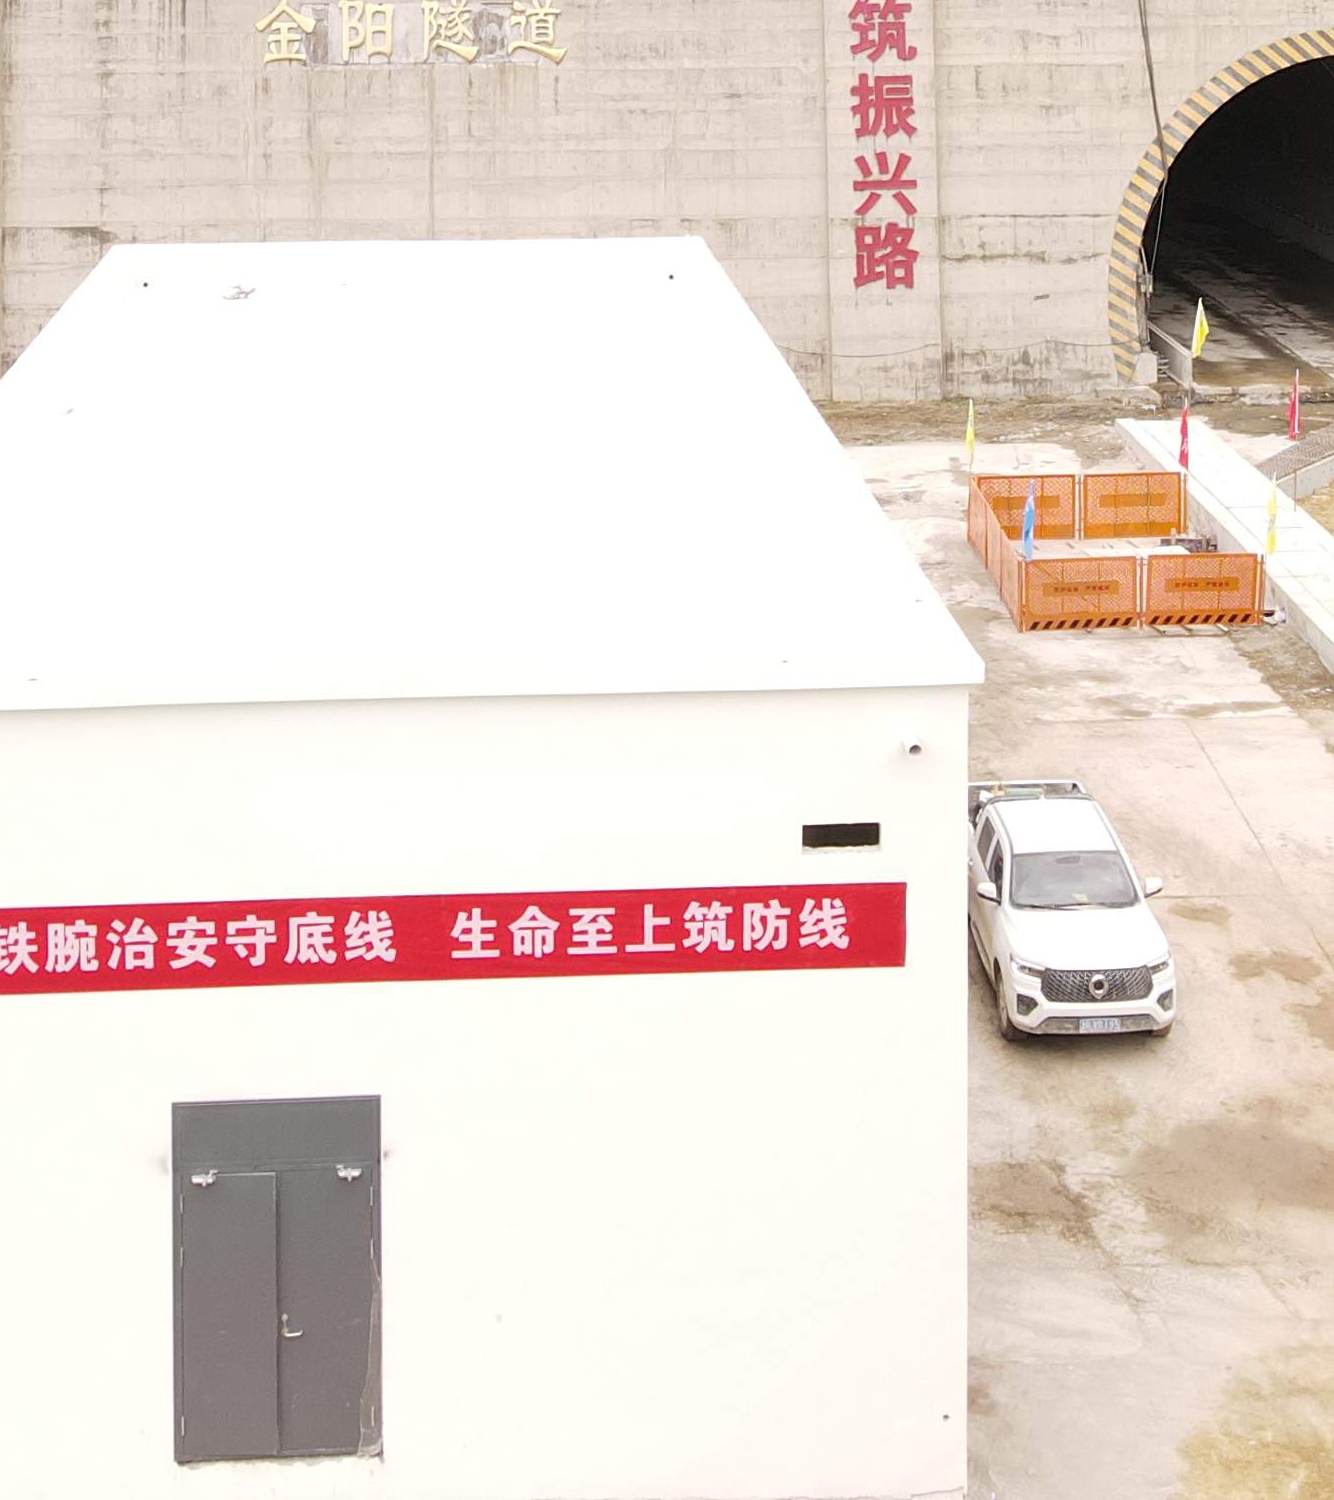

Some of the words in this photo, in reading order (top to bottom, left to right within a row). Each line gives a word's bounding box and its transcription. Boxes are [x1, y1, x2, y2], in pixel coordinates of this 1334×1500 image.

[451, 898, 850, 959] 生命至上筑防线
